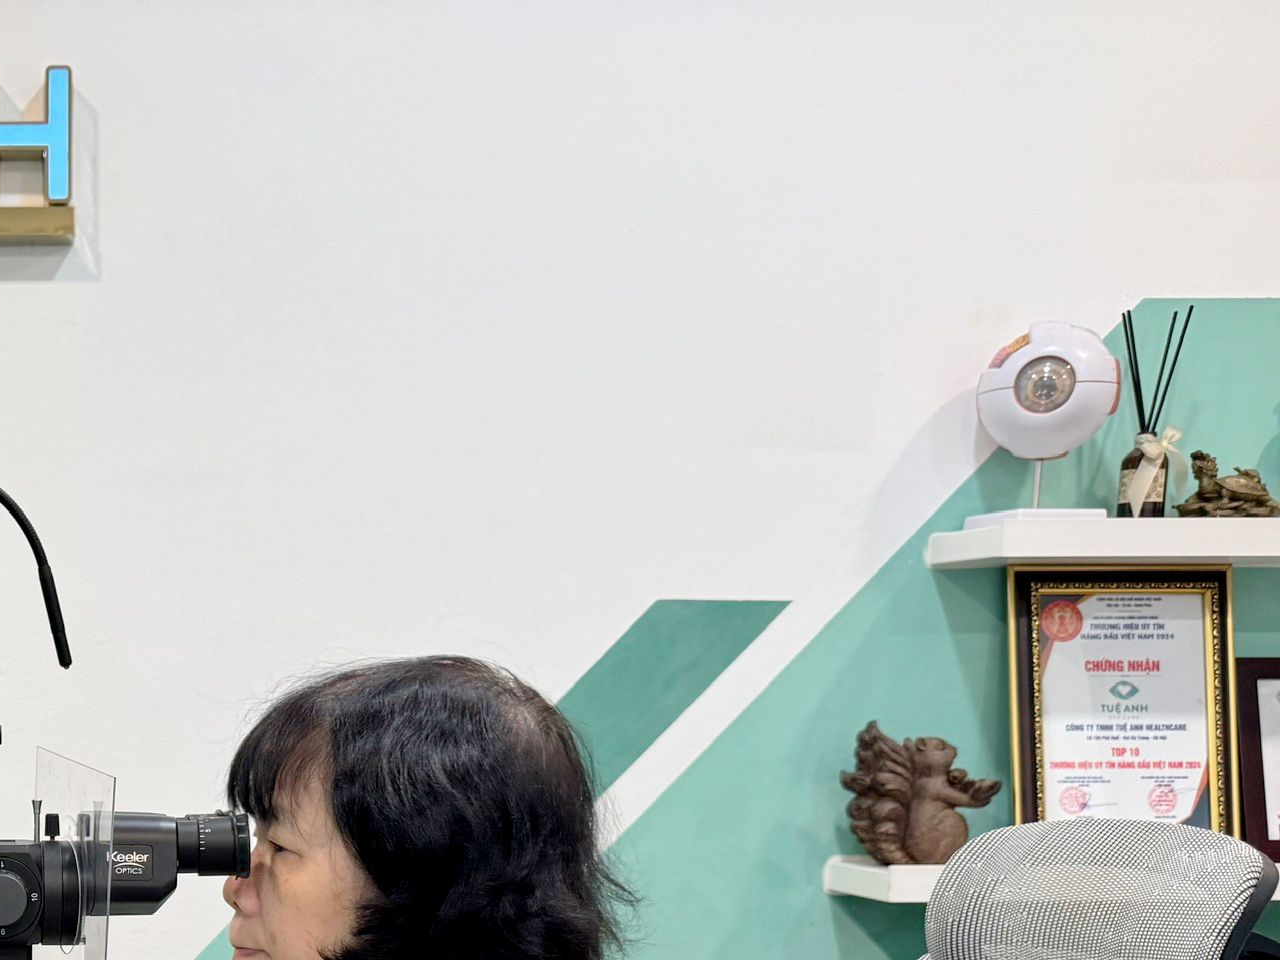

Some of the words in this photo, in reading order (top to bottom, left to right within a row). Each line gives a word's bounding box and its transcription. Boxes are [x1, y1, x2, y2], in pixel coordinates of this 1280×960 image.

[1084, 656, 1124, 673] CHỨNG
[1127, 658, 1161, 675] NHẬN
[1122, 704, 1149, 713] ANH
[106, 851, 149, 862] Keeler
[115, 867, 143, 875] OPTICS
